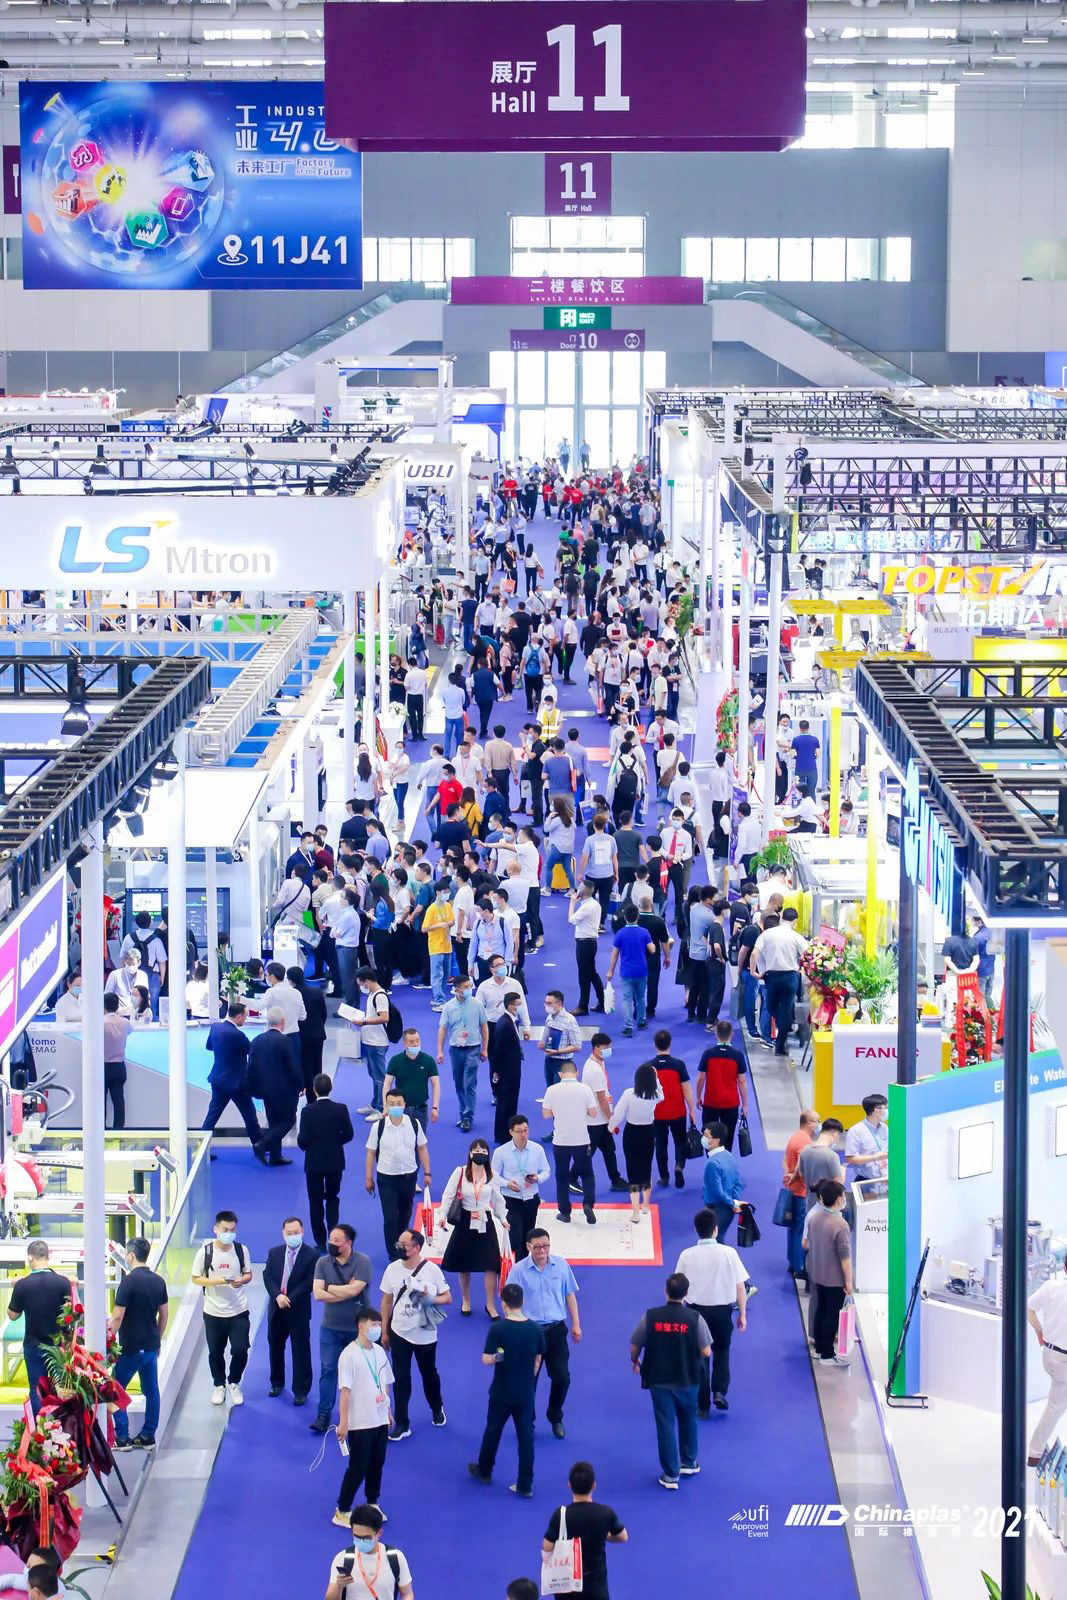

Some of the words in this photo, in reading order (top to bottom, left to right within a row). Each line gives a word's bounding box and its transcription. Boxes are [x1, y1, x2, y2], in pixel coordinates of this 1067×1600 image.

[490, 61, 537, 84] 展厅
[546, 24, 630, 111] 11
[492, 90, 536, 112] Hall
[267, 106, 325, 116] INDUST
[235, 105, 258, 151] 工业
[236, 160, 292, 174] 未来工厂
[296, 158, 334, 168] Factory
[560, 162, 596, 198] 11
[250, 235, 348, 264] 11J41
[530, 279, 625, 294] 二楼餐饮区
[579, 332, 598, 349] 10
[404, 463, 454, 478] UBLI
[58, 526, 152, 574] LS
[166, 546, 271, 574] Mtron
[31, 1037, 56, 1046] tomo
[1043, 1068, 1067, 1082] Wate
